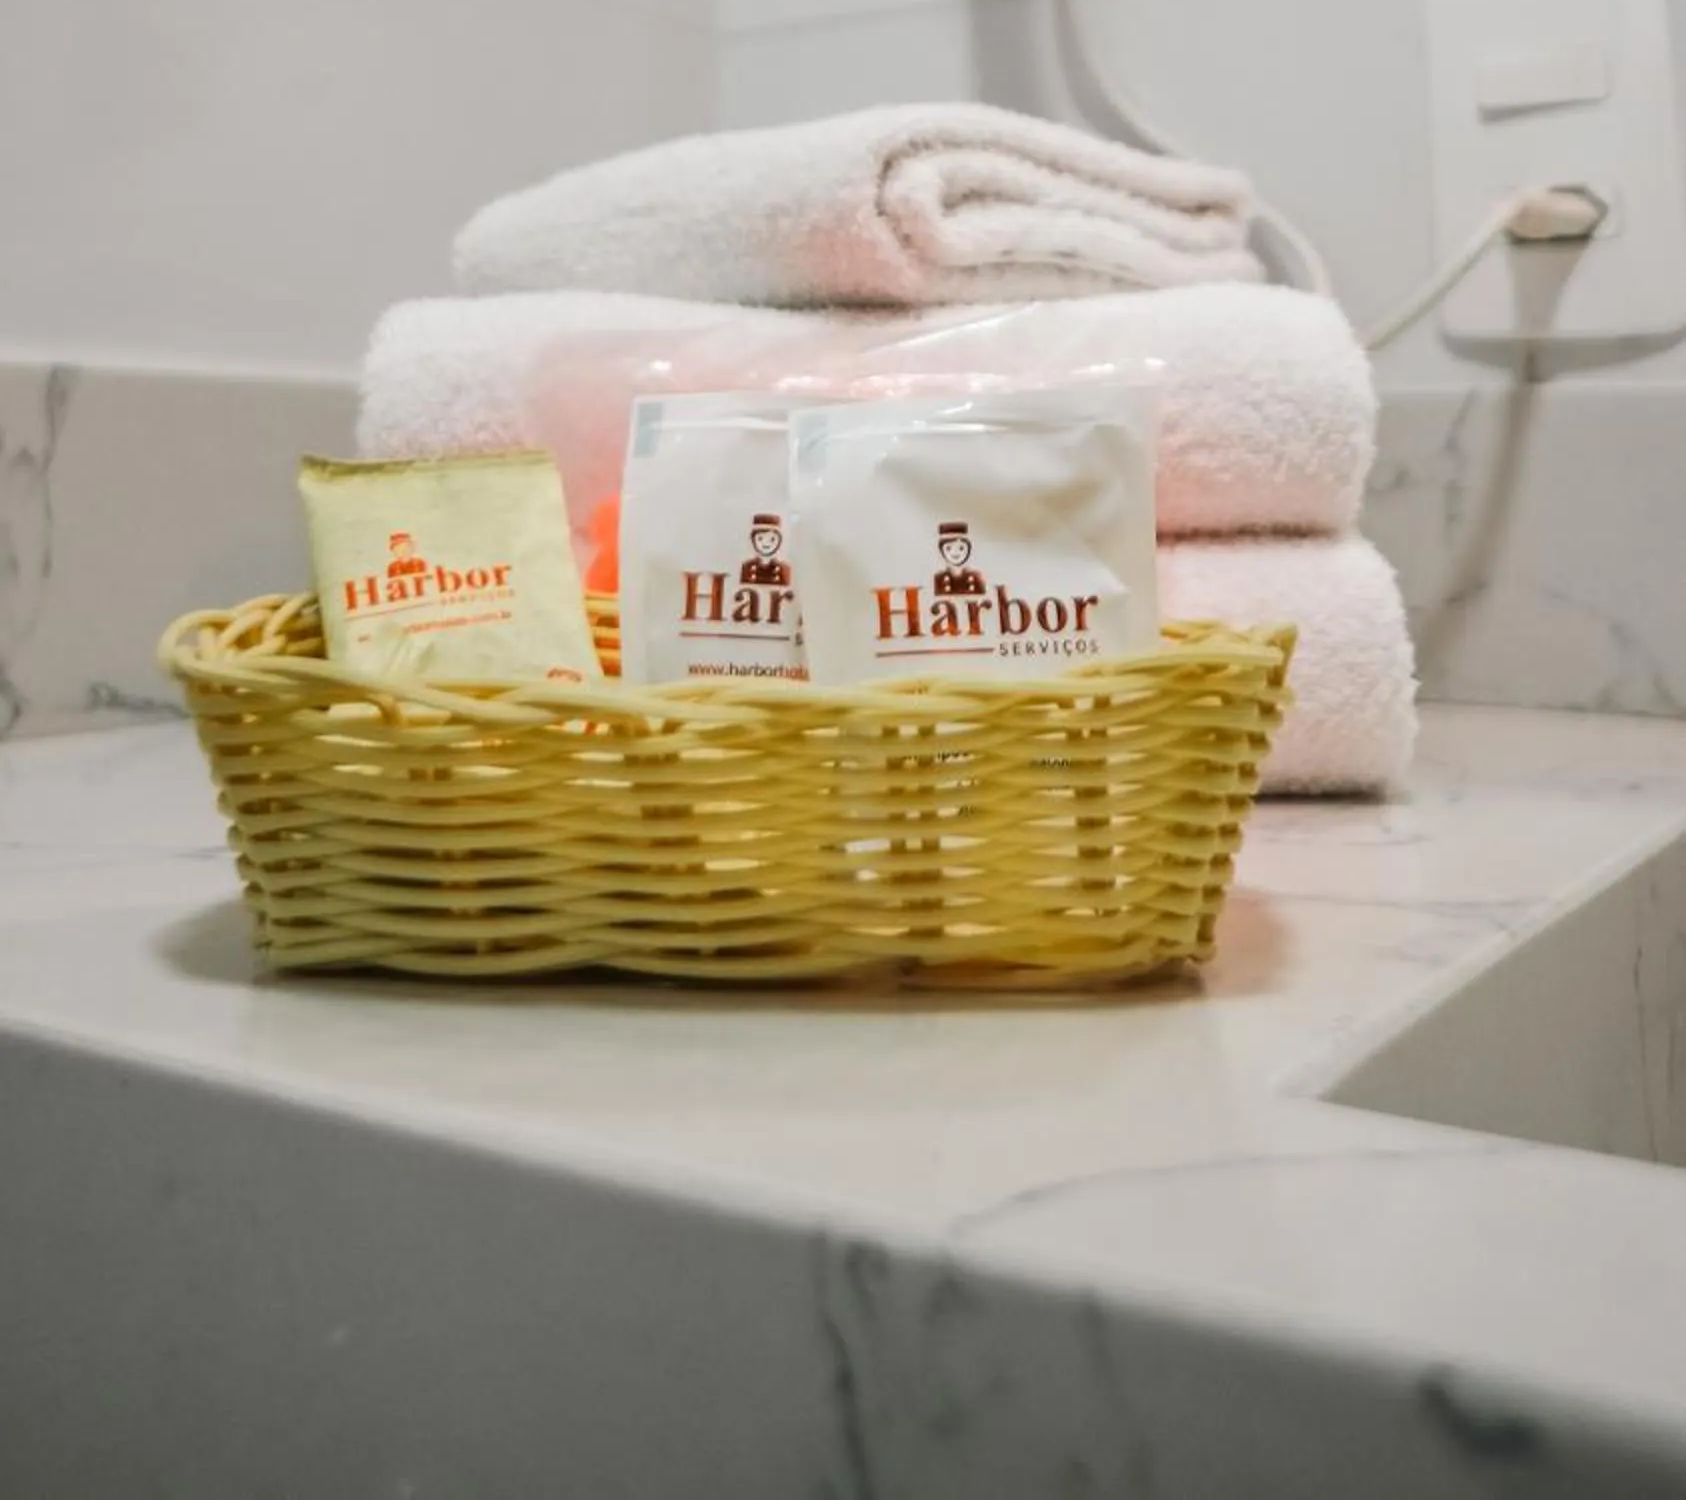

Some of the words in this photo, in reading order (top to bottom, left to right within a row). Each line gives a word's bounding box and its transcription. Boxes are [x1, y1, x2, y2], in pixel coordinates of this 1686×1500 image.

[344, 563, 512, 612] Harbor
[681, 571, 803, 625] Har
[871, 584, 1099, 640] Harbor
[999, 638, 1100, 657] SERVIÇOS
